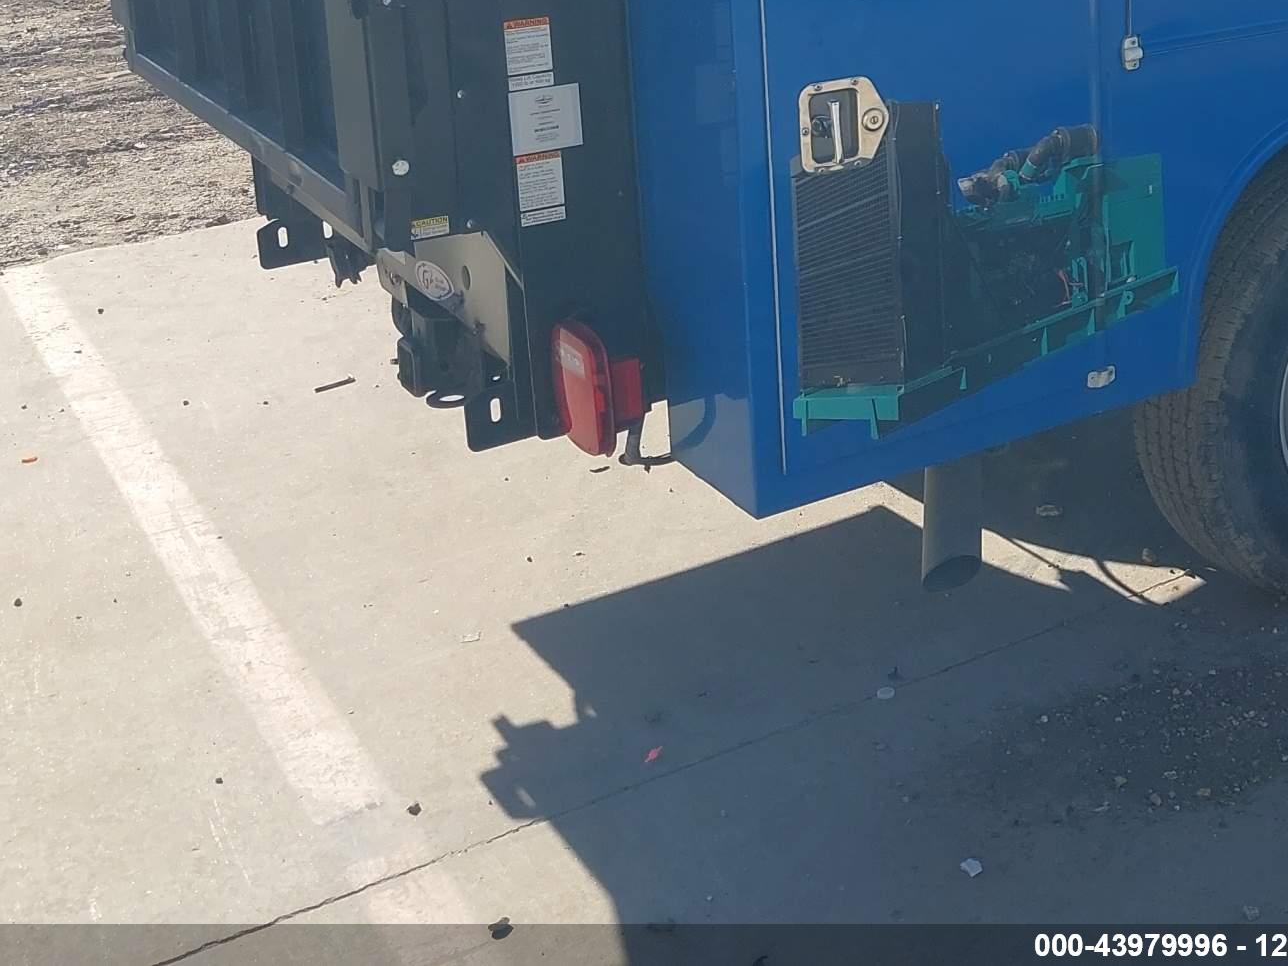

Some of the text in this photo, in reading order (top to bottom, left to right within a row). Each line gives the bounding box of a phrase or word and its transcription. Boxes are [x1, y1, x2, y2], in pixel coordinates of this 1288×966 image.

[515, 18, 547, 28] WARNING
[526, 152, 560, 162] WARNING
[415, 217, 448, 227] CAUTION
